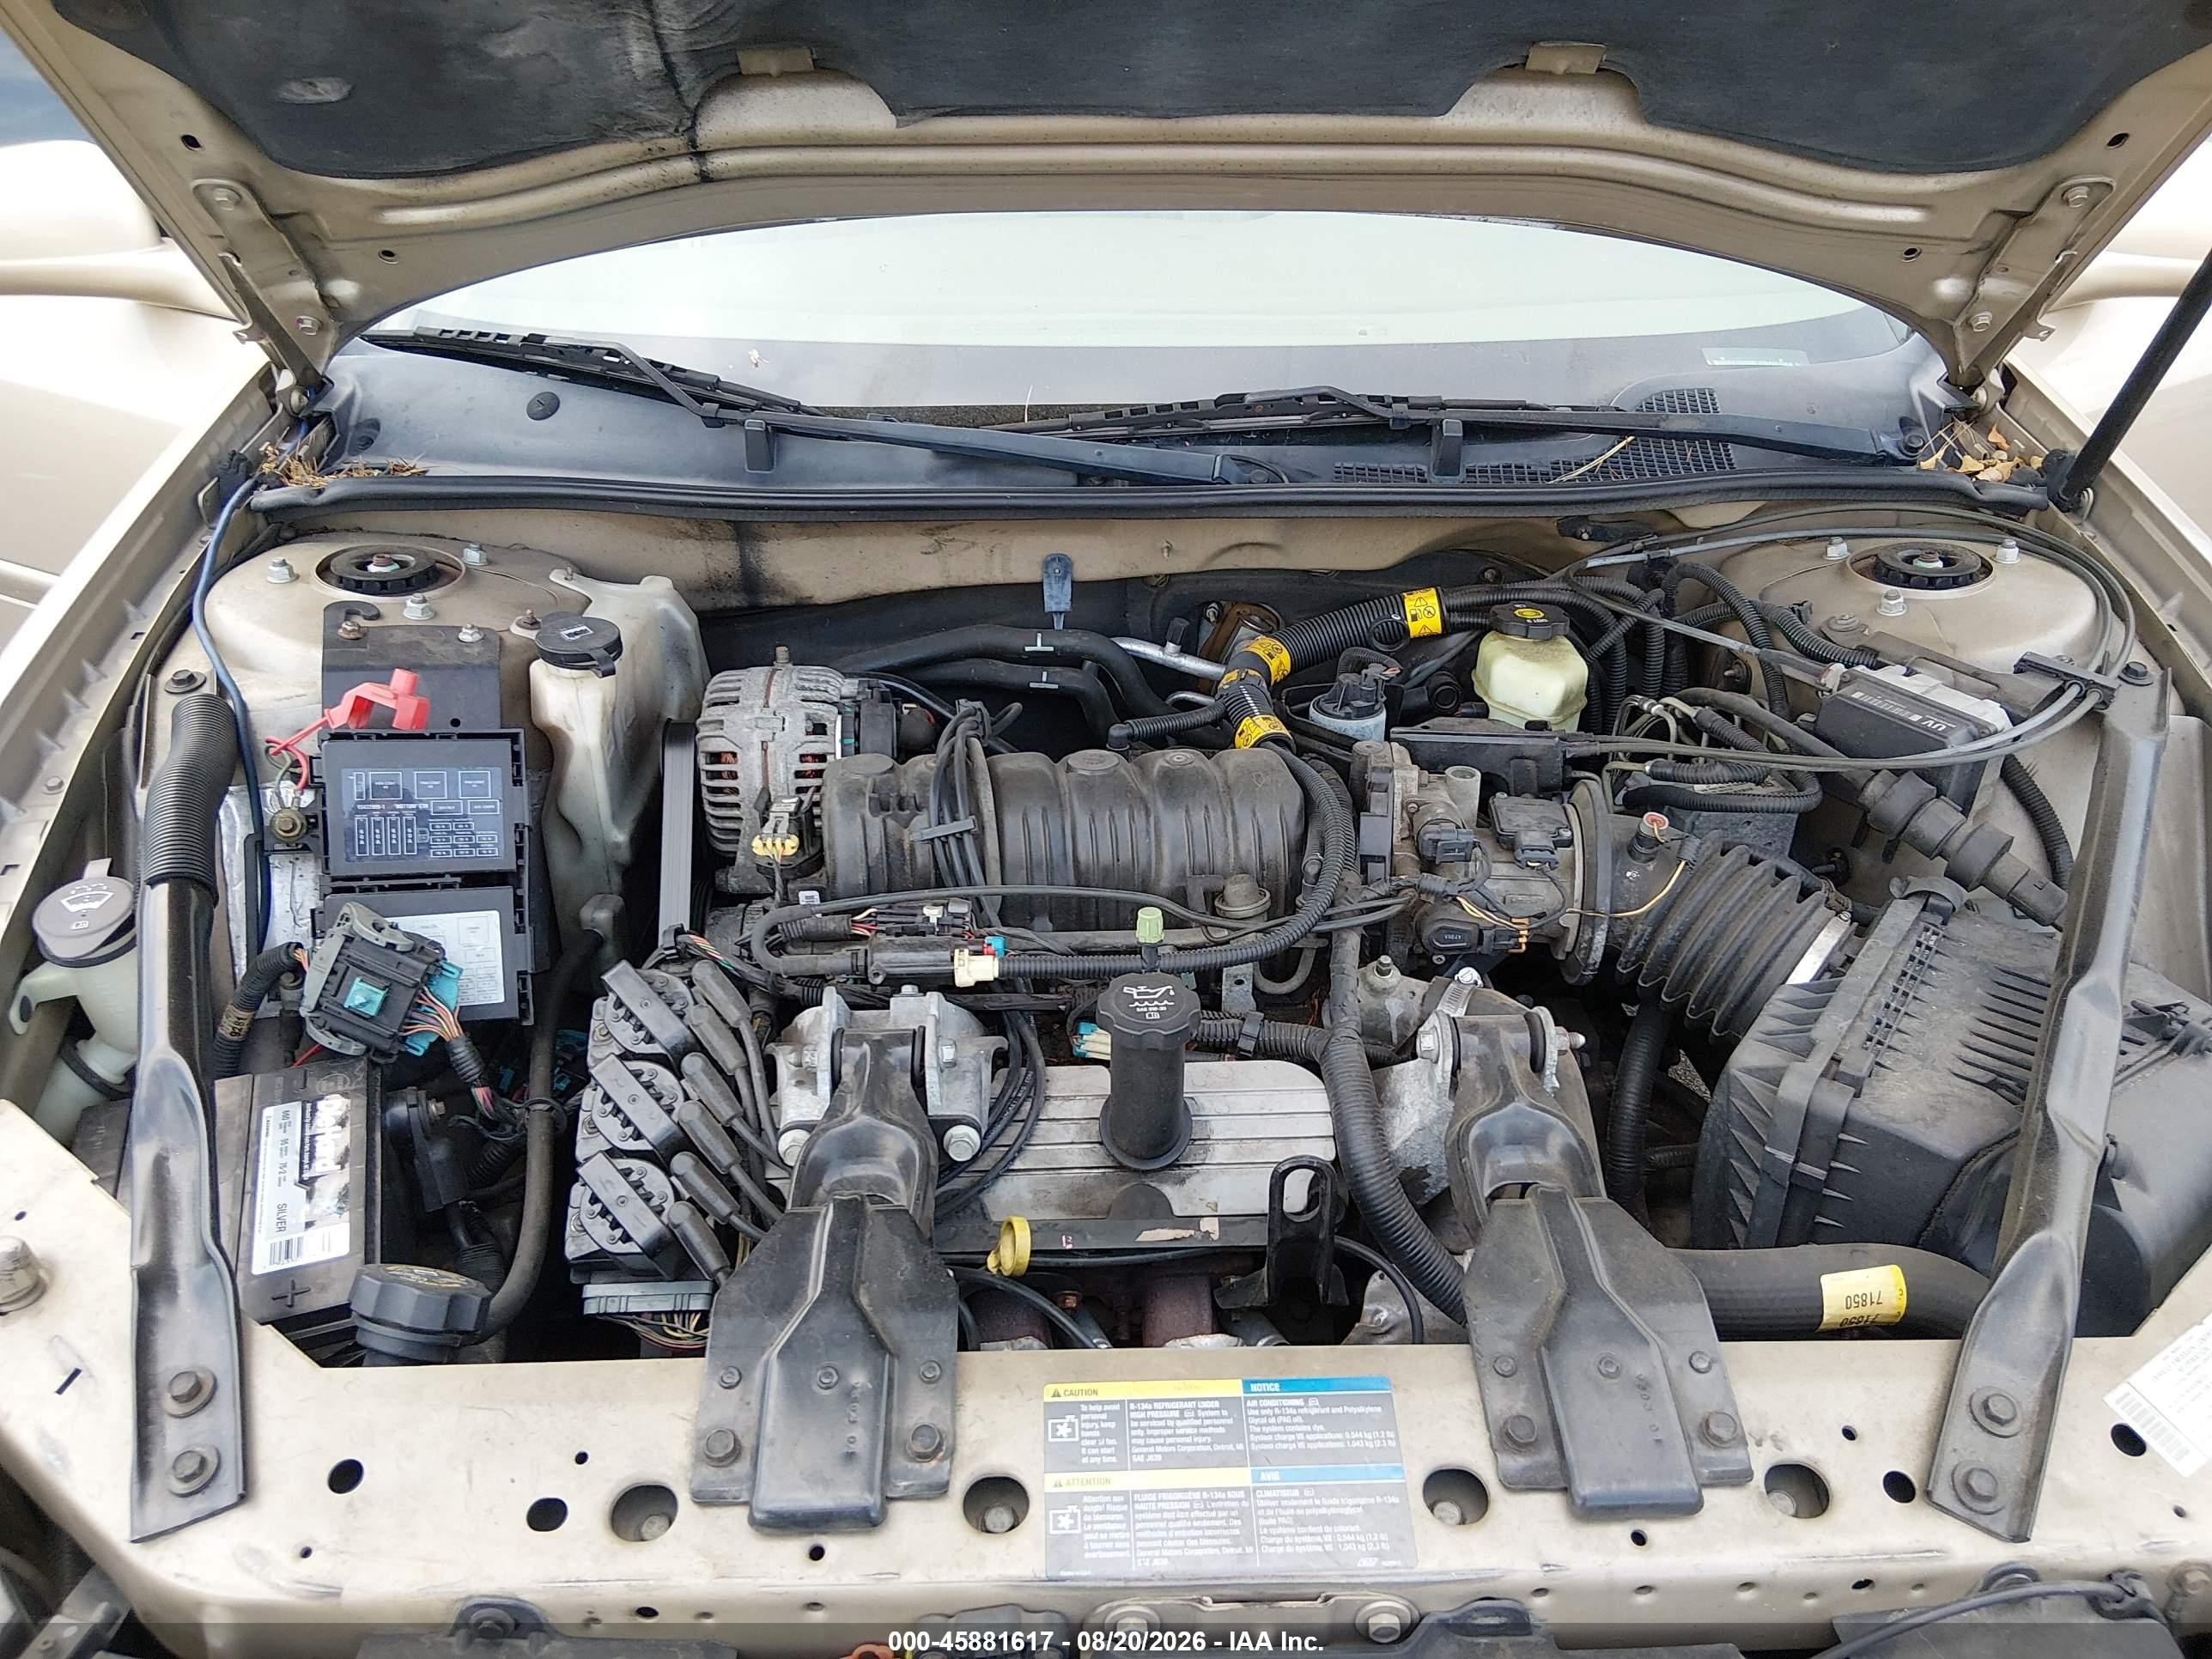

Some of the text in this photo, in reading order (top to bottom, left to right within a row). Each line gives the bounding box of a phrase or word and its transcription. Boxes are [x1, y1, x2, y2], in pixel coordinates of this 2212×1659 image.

[276, 1203, 288, 1232] SILVER
[1845, 1290, 1883, 1310] 71850
[1063, 1388, 1098, 1396] CAUTION
[1250, 1382, 1280, 1392] NOTICE
[1260, 1470, 1281, 1481] AVIS
[1066, 1477, 1111, 1486] ATTENTION
